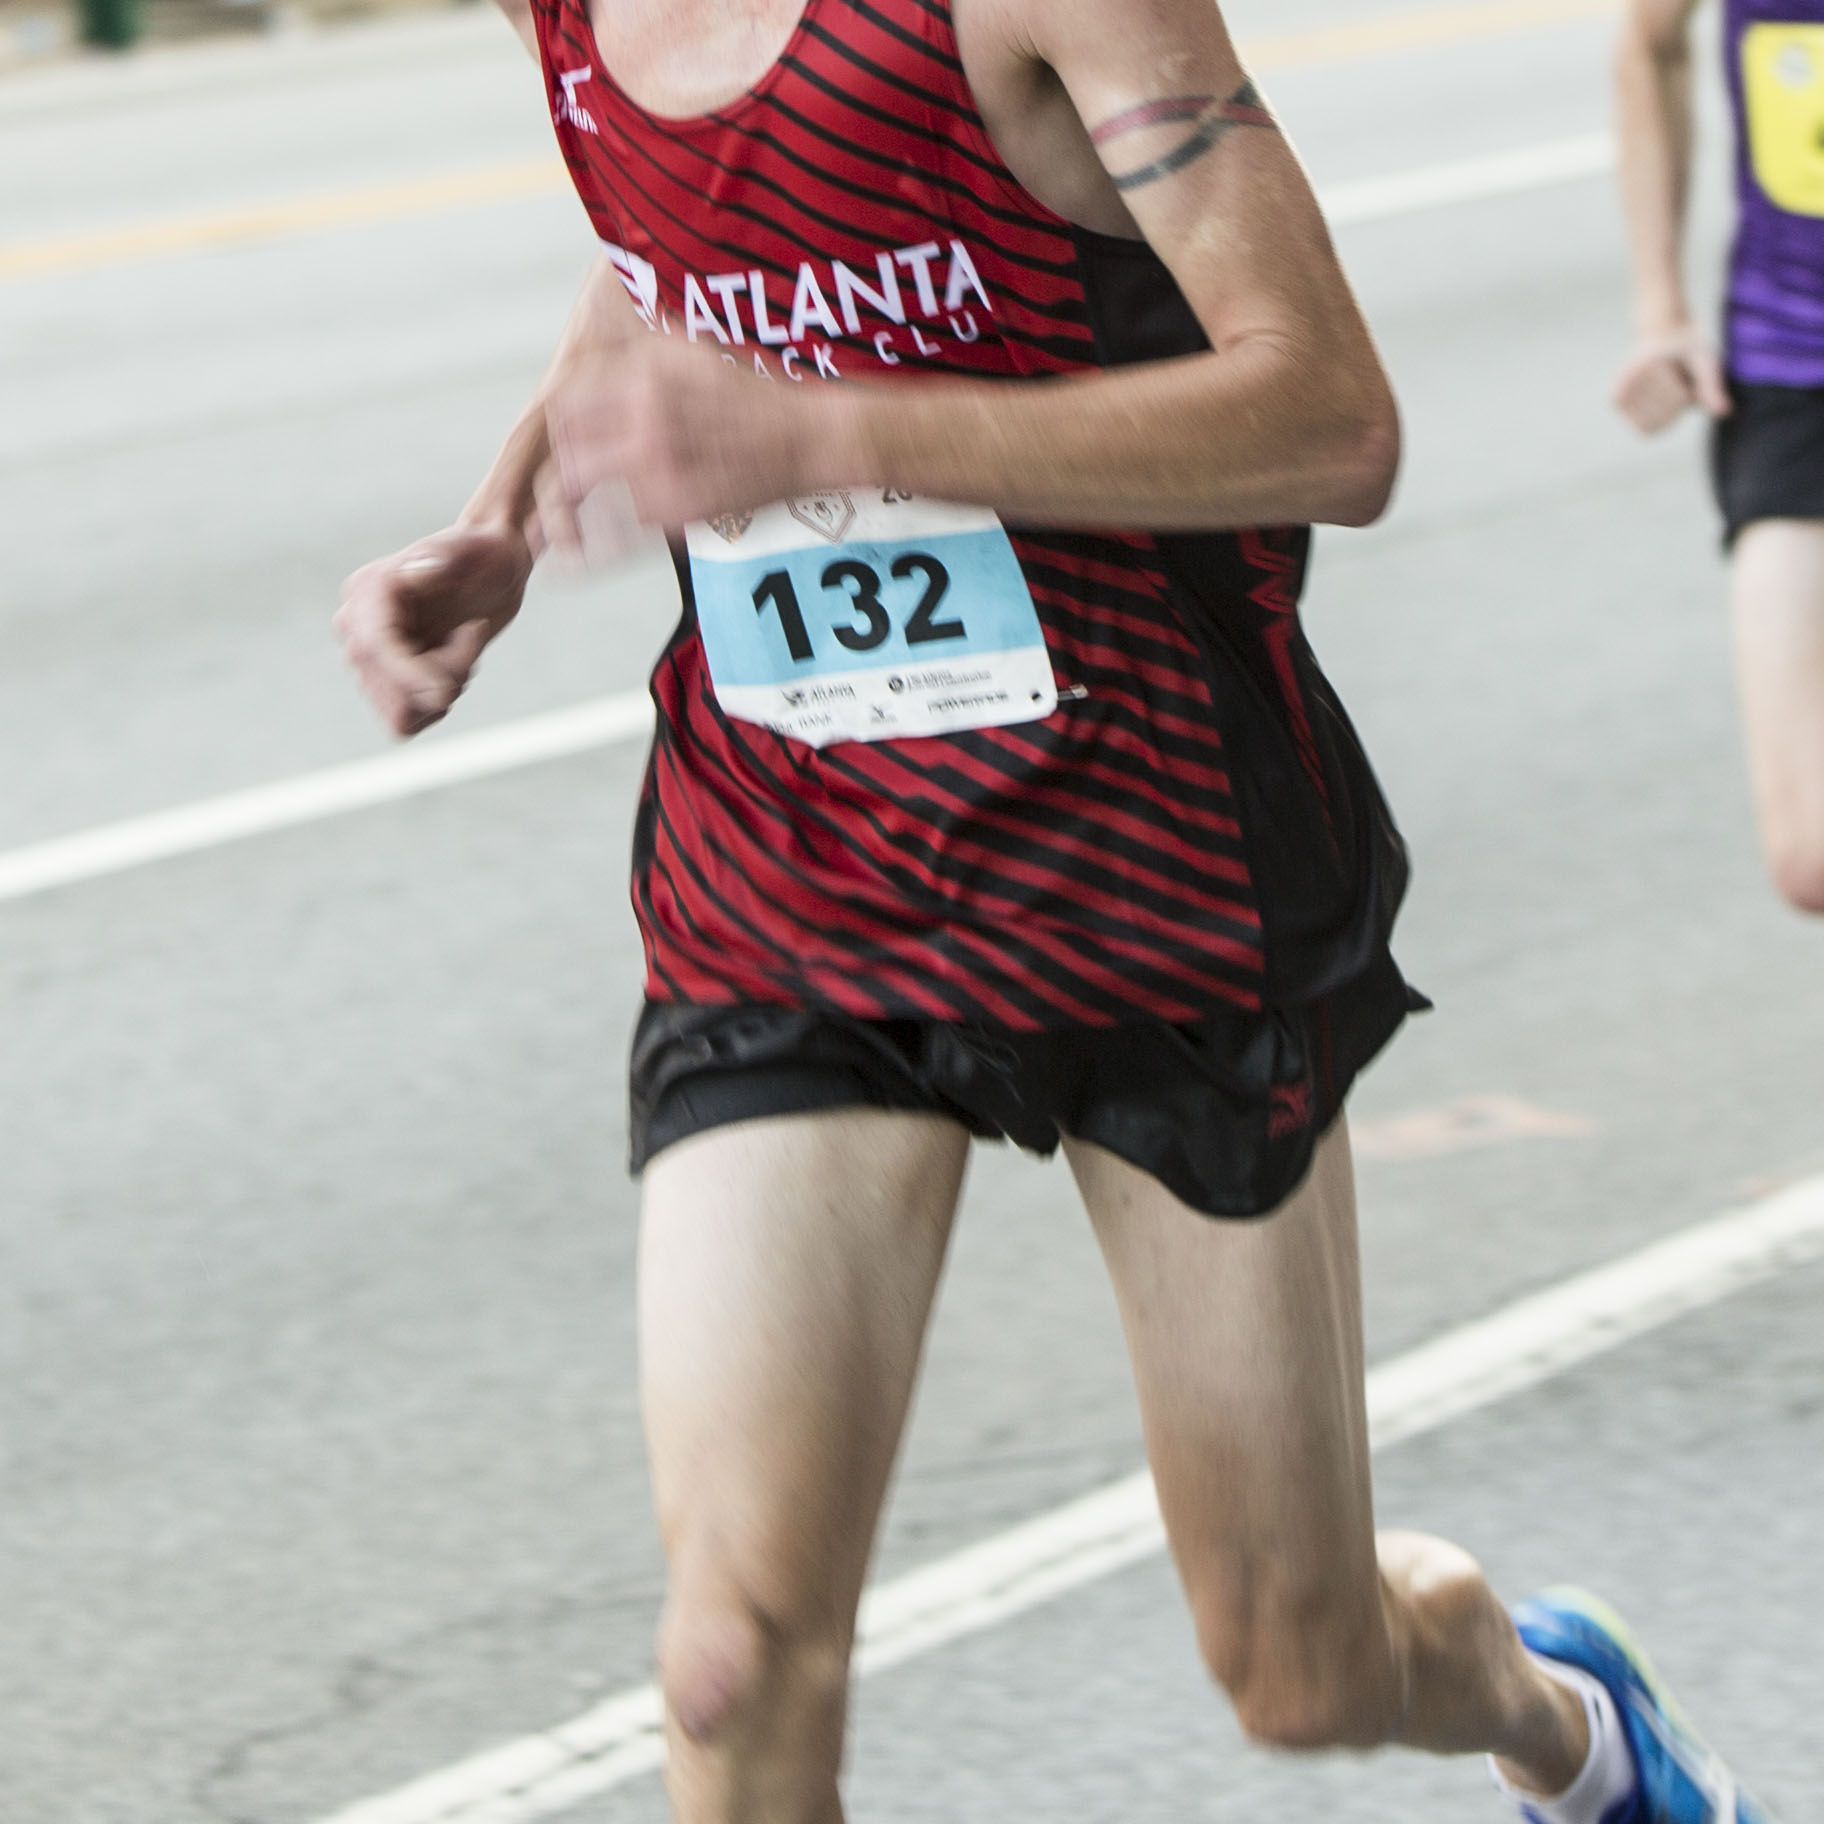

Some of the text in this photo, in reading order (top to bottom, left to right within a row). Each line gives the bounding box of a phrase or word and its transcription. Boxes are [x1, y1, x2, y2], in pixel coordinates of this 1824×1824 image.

[684, 239, 992, 345] ATLANTA
[721, 310, 980, 382] ACK CLU
[751, 553, 965, 663] 132
